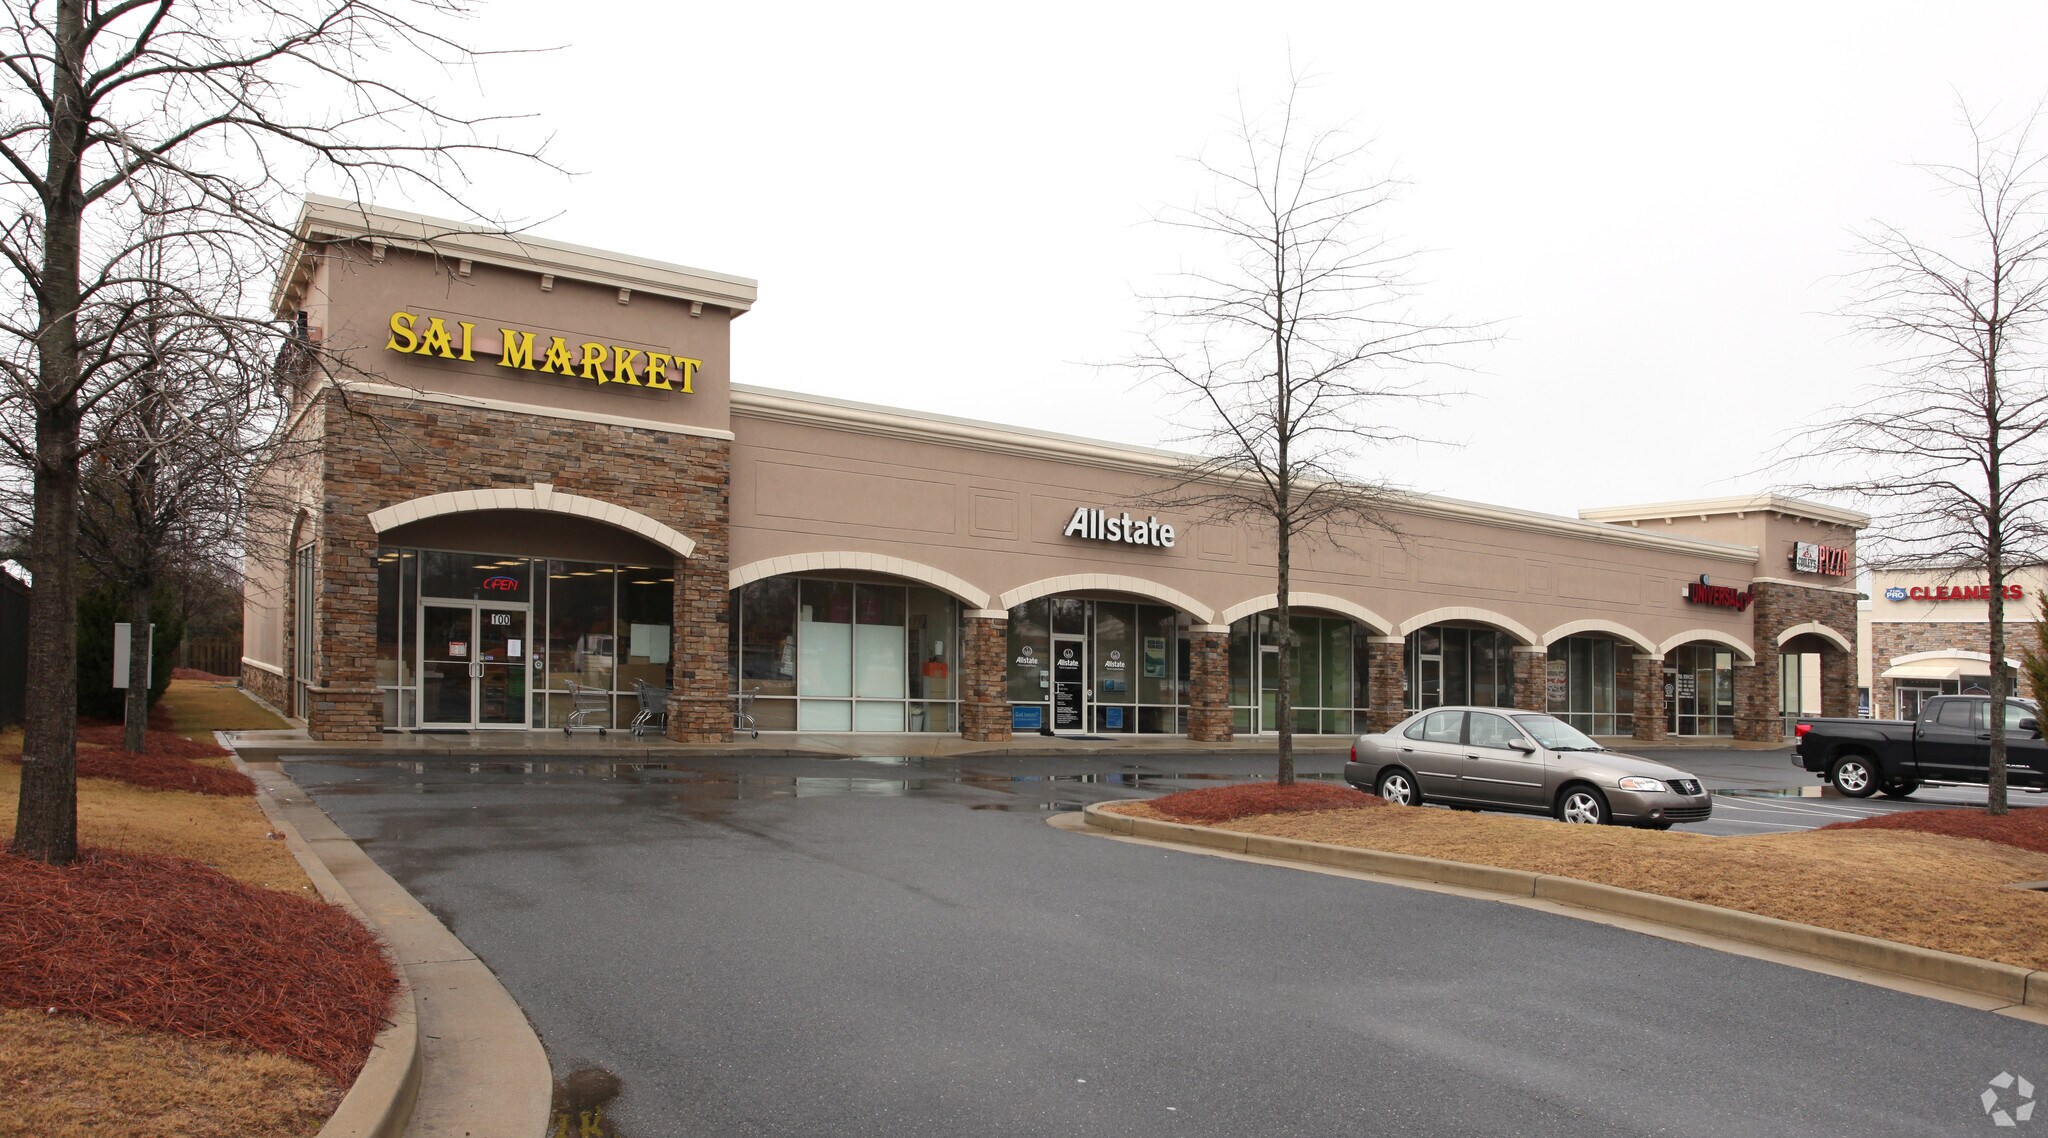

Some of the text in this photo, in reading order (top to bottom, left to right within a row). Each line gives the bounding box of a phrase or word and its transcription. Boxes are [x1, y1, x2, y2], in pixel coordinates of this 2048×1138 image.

[385, 311, 703, 394] SAI MARKET
[1064, 507, 1175, 548] Allstate
[1819, 546, 1848, 577] PIZZA
[483, 578, 519, 591] OPEN
[1689, 583, 1741, 608] UNIVERSAL
[493, 614, 510, 625] 100
[1016, 656, 1038, 665] Allstate
[1057, 659, 1079, 667] Allstate
[1105, 660, 1126, 668] Allstate
